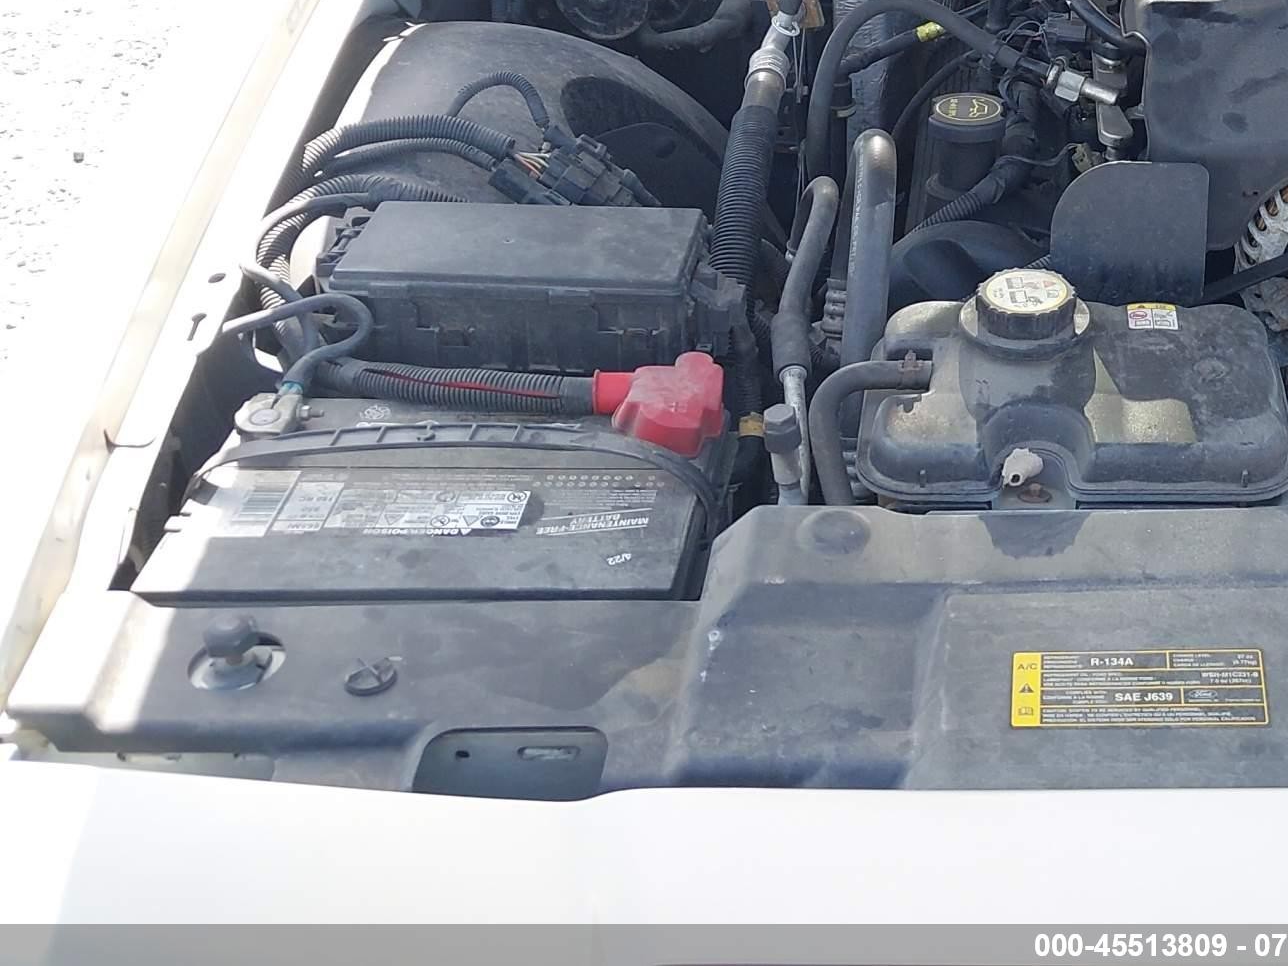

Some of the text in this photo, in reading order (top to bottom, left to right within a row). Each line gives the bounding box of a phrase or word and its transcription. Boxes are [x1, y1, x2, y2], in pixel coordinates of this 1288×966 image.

[570, 514, 621, 525] BATTERY
[536, 517, 649, 535] MAINTENANCE-FREE
[606, 553, 632, 565] 4/22
[1017, 662, 1038, 670] A/C
[1090, 657, 1134, 666] R-134A
[1114, 692, 1173, 701] SAE J639
